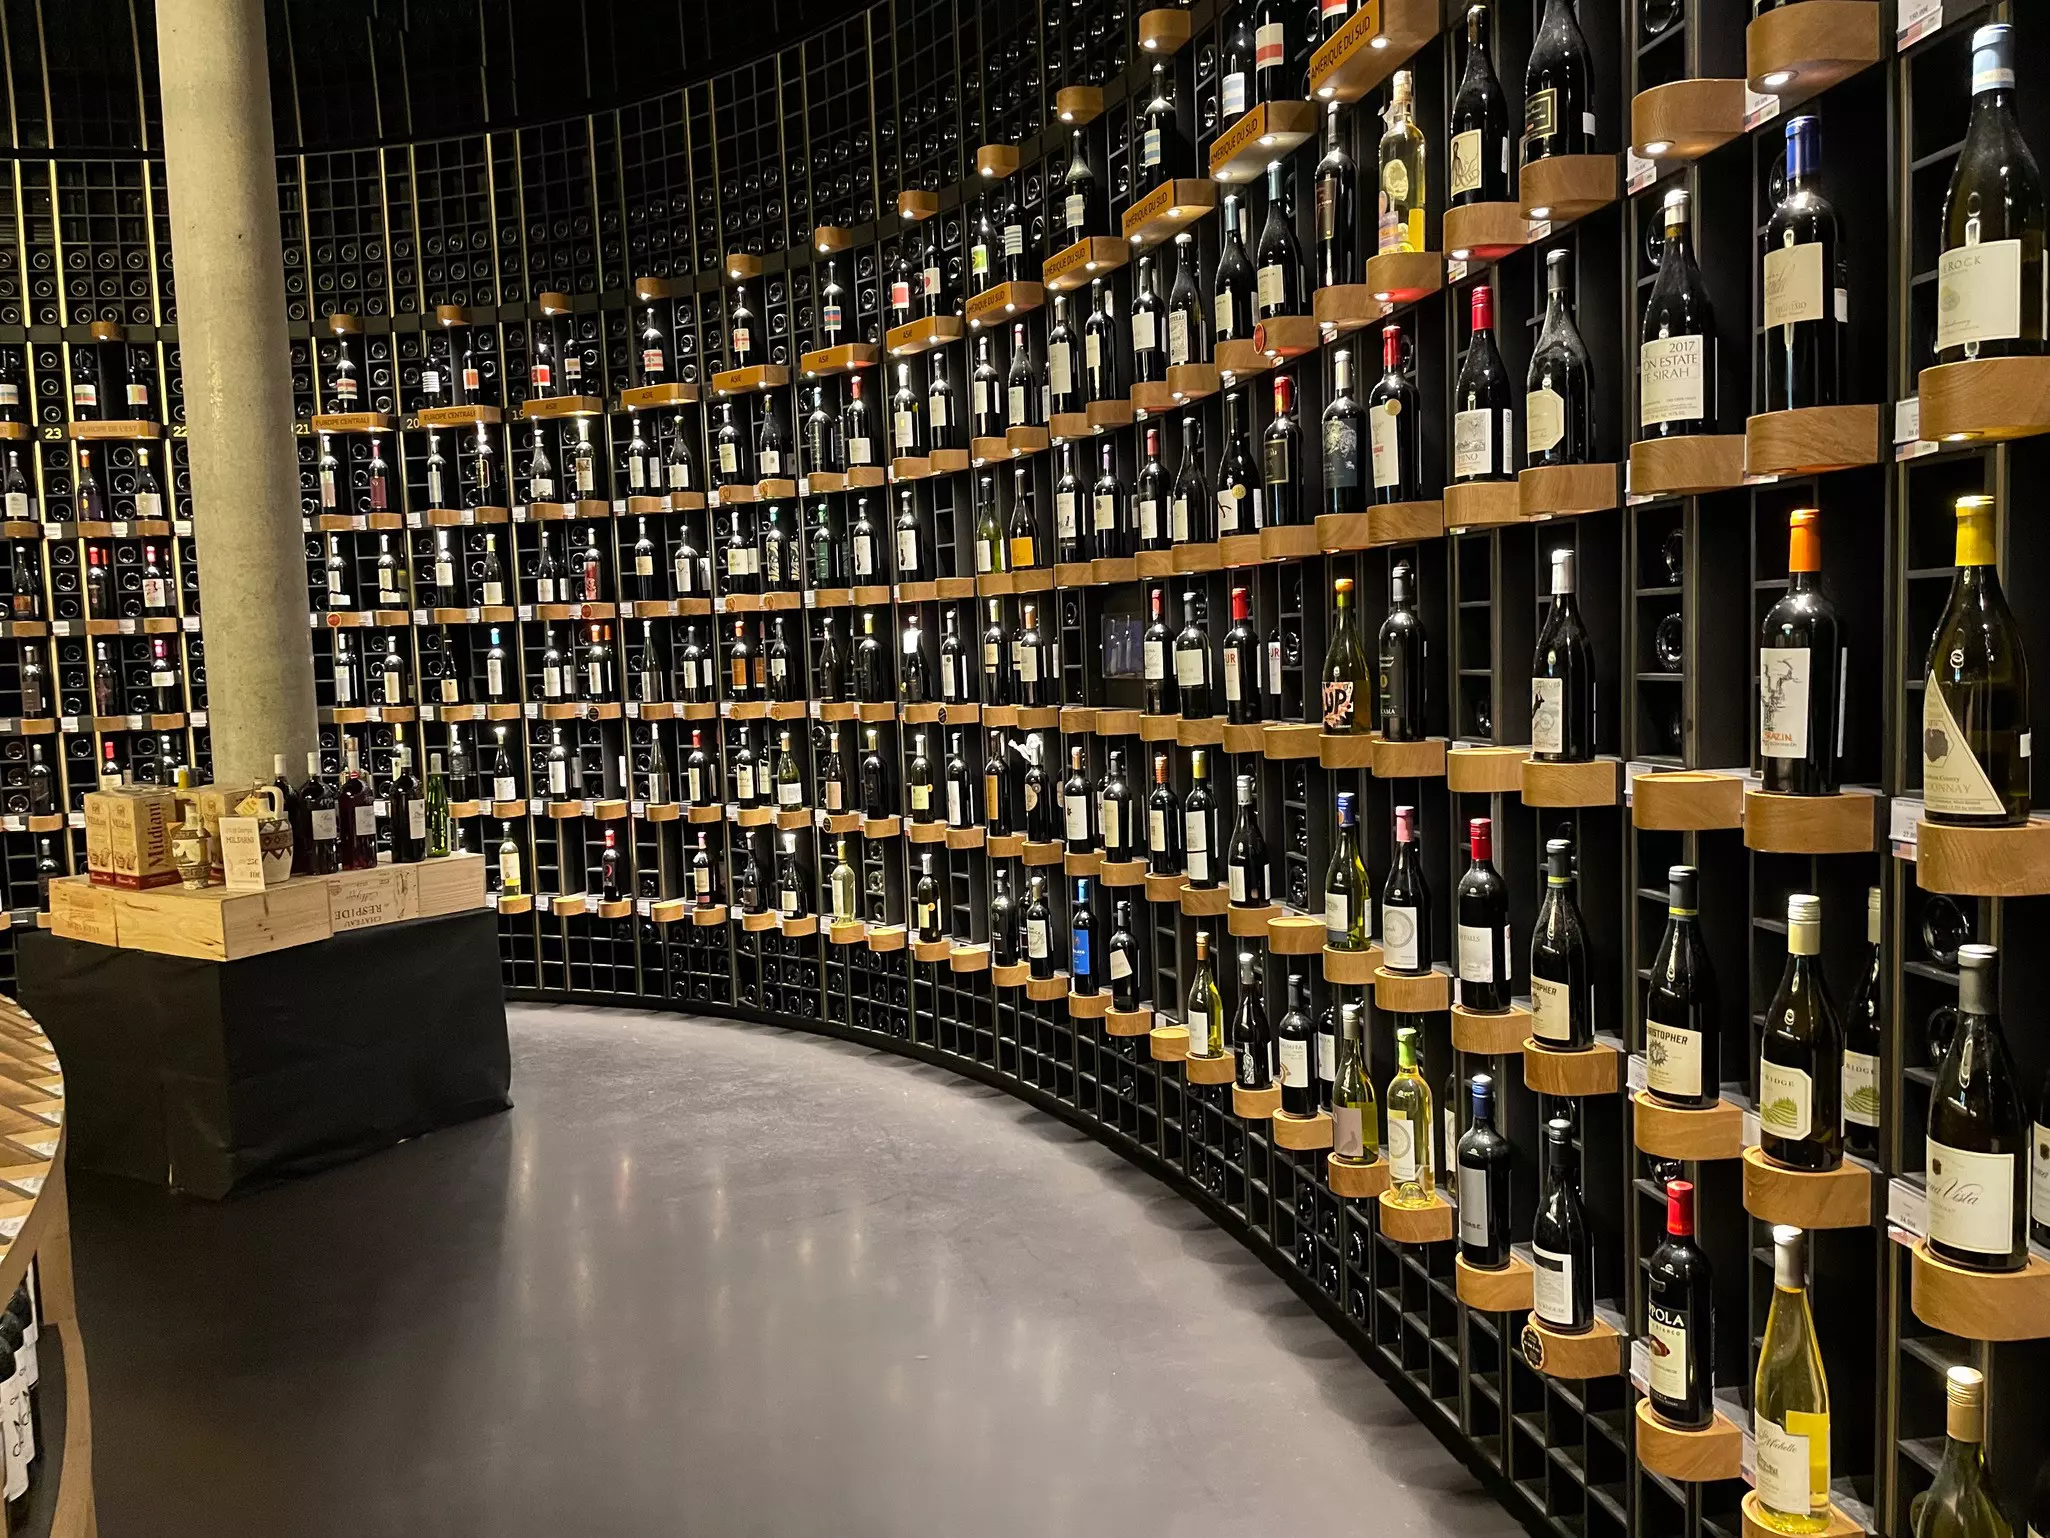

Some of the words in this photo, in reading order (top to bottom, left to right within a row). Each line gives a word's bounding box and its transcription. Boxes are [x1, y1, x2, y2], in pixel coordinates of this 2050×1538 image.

[1311, 41, 1343, 79] AMÉRIQUE
[1343, 32, 1354, 51] DU
[1355, 16, 1371, 40] SUD
[1236, 129, 1246, 145] DU
[1245, 118, 1258, 136] SUD
[1124, 207, 1148, 229] AMÉRIQUE
[1148, 202, 1157, 215] DU
[1157, 191, 1168, 210] SUD
[1044, 256, 1067, 277] AMÉRIQUE
[1066, 253, 1075, 266] DU
[1075, 247, 1086, 262] SUD
[987, 295, 996, 307] DU
[995, 291, 1006, 303] SUD
[1669, 341, 1695, 353] 2017
[1659, 353, 1698, 367] ESTATE
[730, 374, 742, 384] ASIE
[1653, 367, 1689, 380] SIRAH
[315, 418, 339, 427] EUROPE
[340, 416, 370, 427] CENTRALE
[423, 412, 450, 422] EUROPE
[449, 410, 476, 420] CENTRALE
[512, 409, 524, 421] 19
[296, 424, 311, 435] 21
[406, 417, 420, 430] 20
[45, 427, 62, 440] 23
[173, 425, 188, 437] 22
[145, 801, 169, 869] Mildiani
[334, 904, 382, 921] RESPIDE
[1764, 1074, 1795, 1087] RIDGE
[1944, 1177, 1984, 1205] Vista
[1761, 1438, 1798, 1453] Michelle
